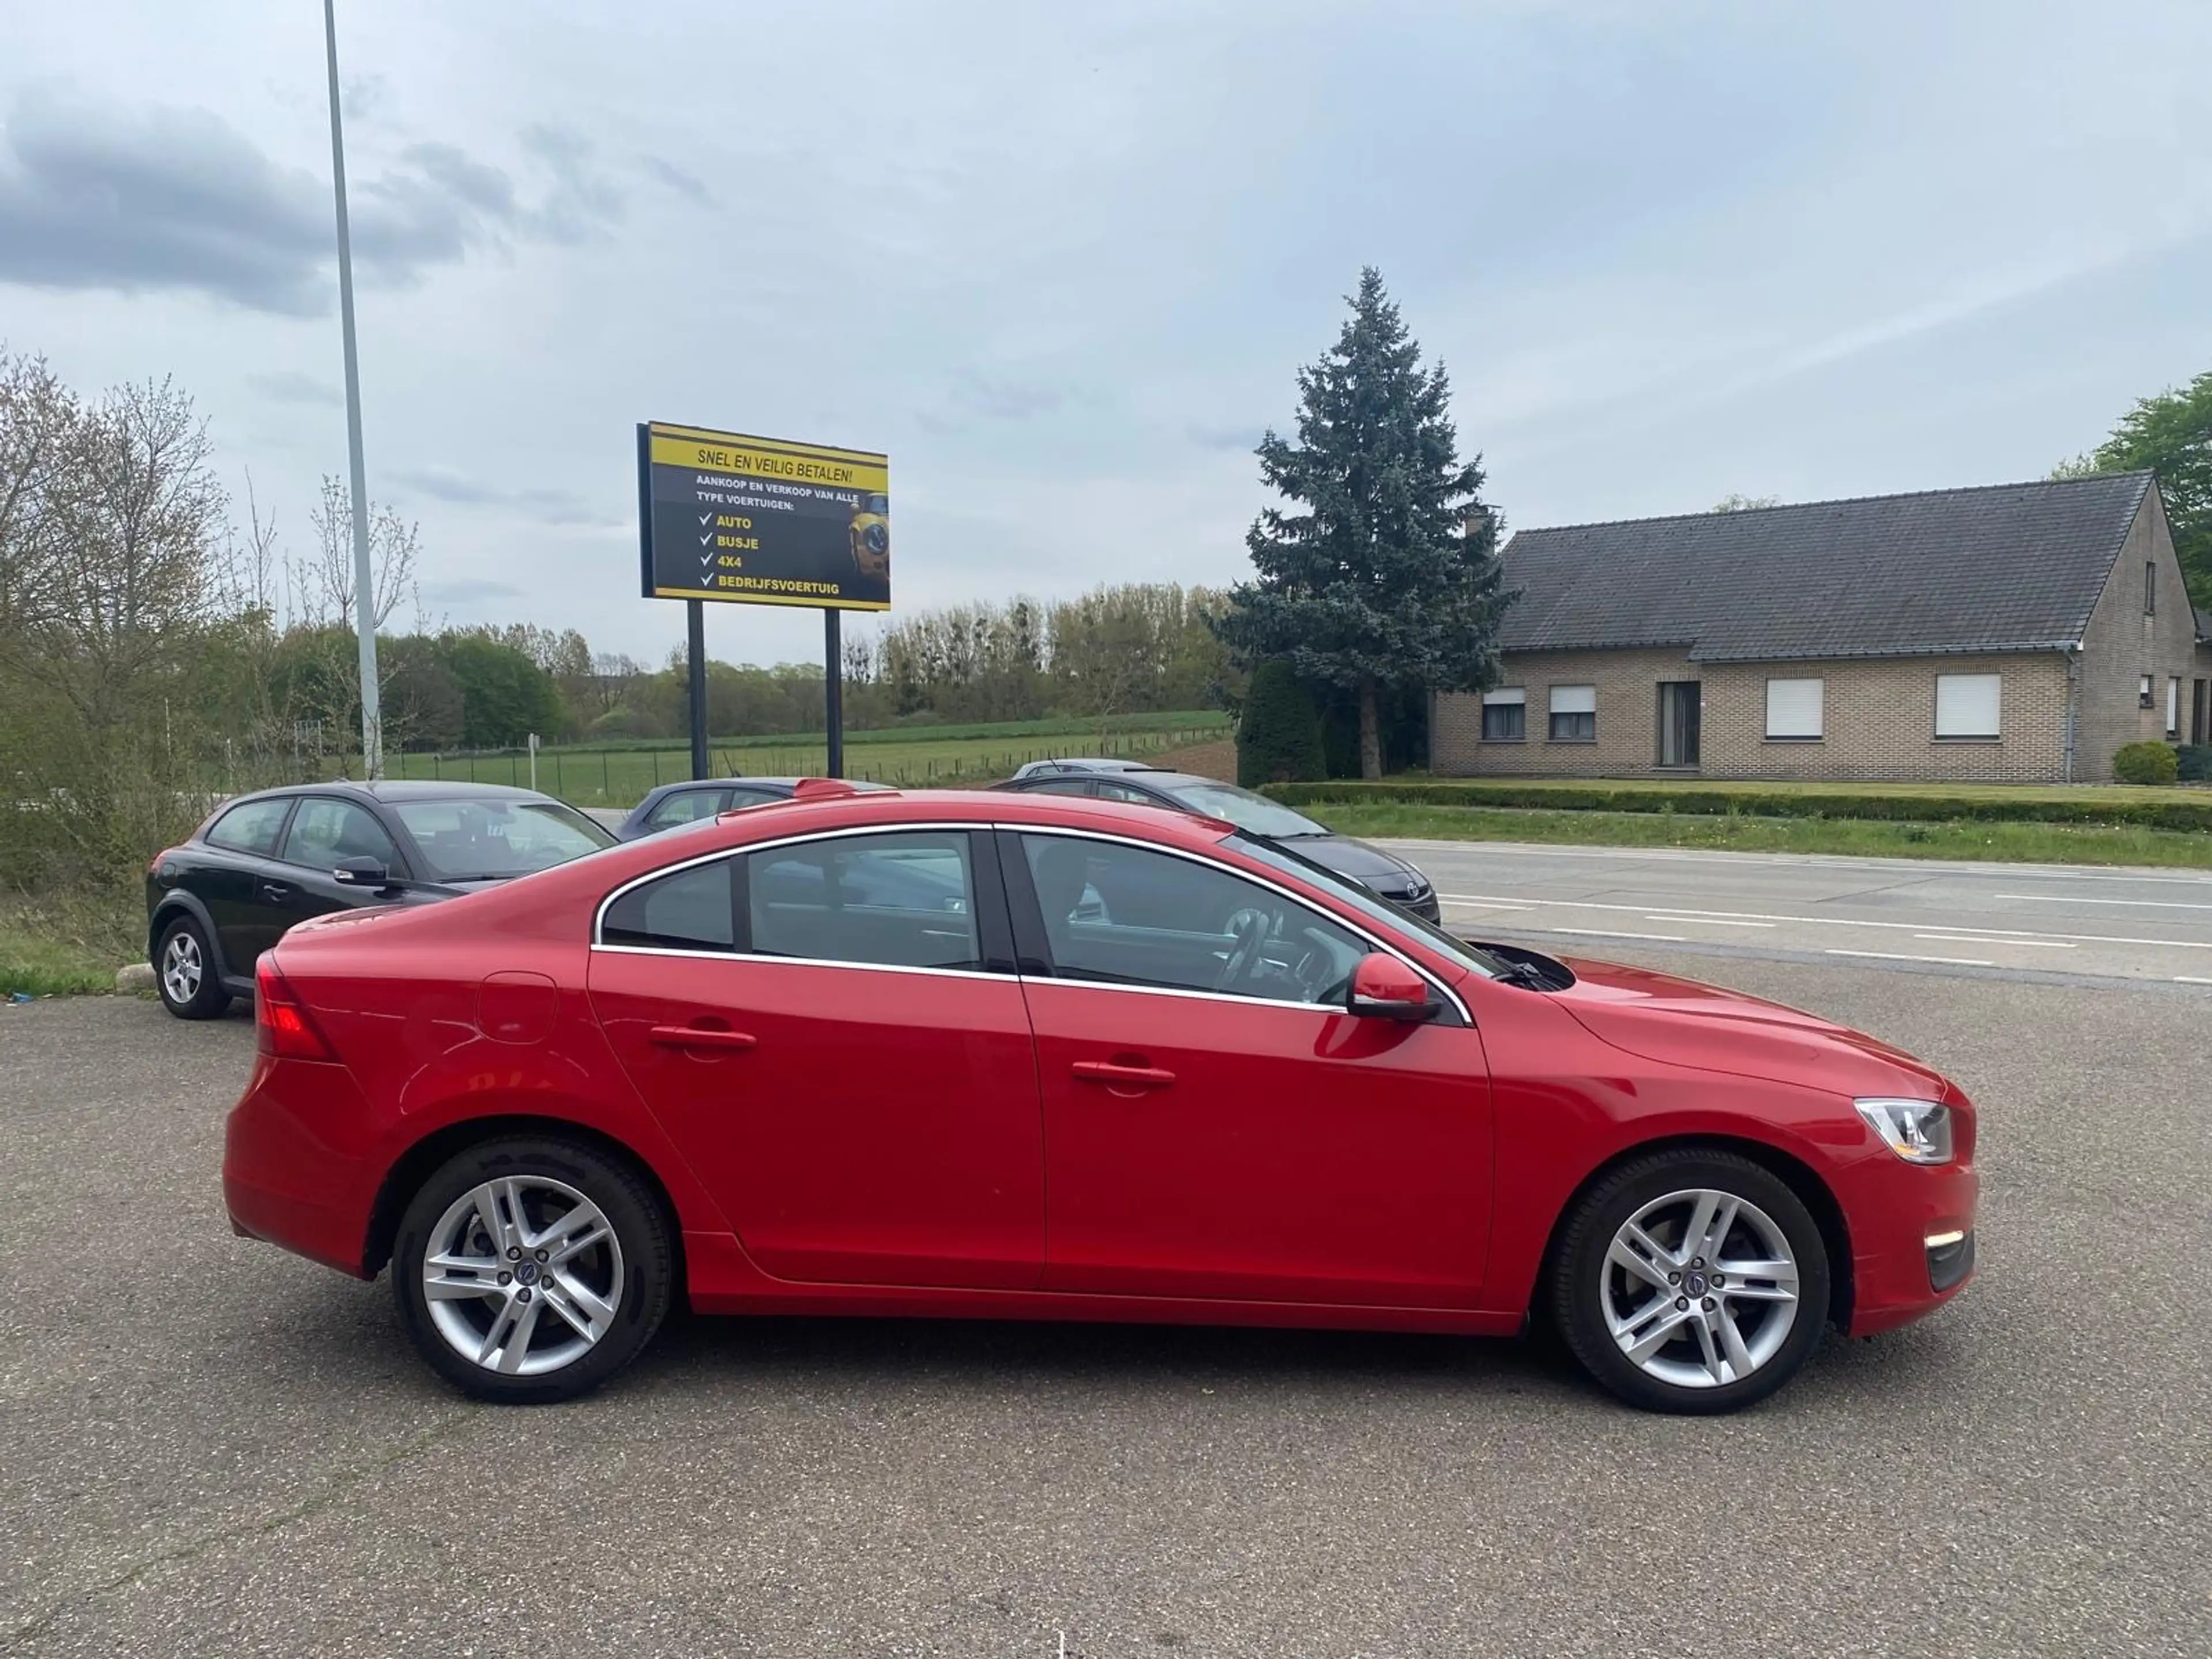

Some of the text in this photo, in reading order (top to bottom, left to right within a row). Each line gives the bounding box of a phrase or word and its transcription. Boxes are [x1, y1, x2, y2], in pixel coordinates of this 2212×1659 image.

[698, 449, 853, 482] SNEL EN VEILIG BETALEN!
[696, 476, 859, 503] AANKOOP EN VERKOOP VAN ALLE
[696, 492, 794, 510] TYPE VOERTUIGEN:
[717, 516, 751, 529] AUTO
[717, 536, 759, 550] BUSJE
[717, 556, 741, 567] 4X4
[719, 576, 839, 594] BEDRIJFSVOERTUIG
